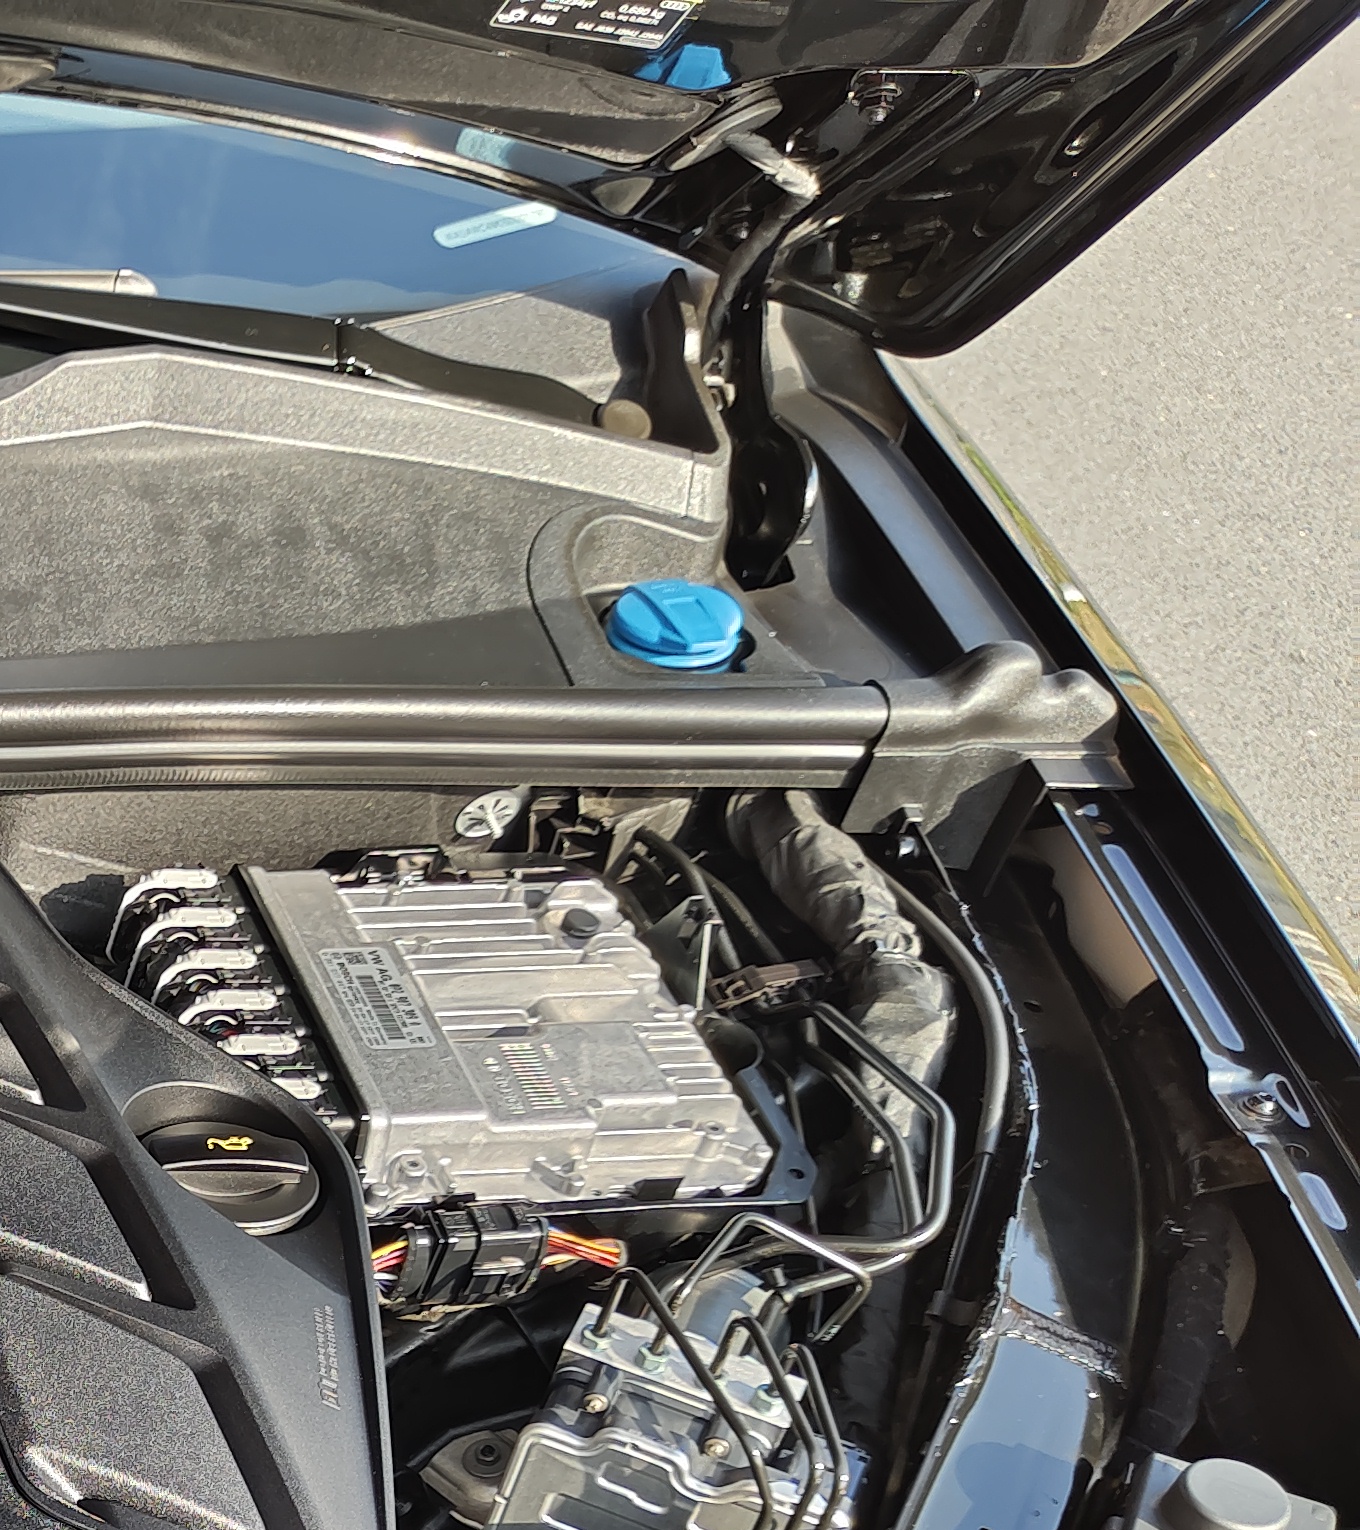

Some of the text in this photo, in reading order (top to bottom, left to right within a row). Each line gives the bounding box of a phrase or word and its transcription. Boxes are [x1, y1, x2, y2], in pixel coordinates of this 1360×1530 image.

[530, 14, 558, 26] PAG
[365, 949, 386, 965] VW
[374, 967, 394, 982] AG
